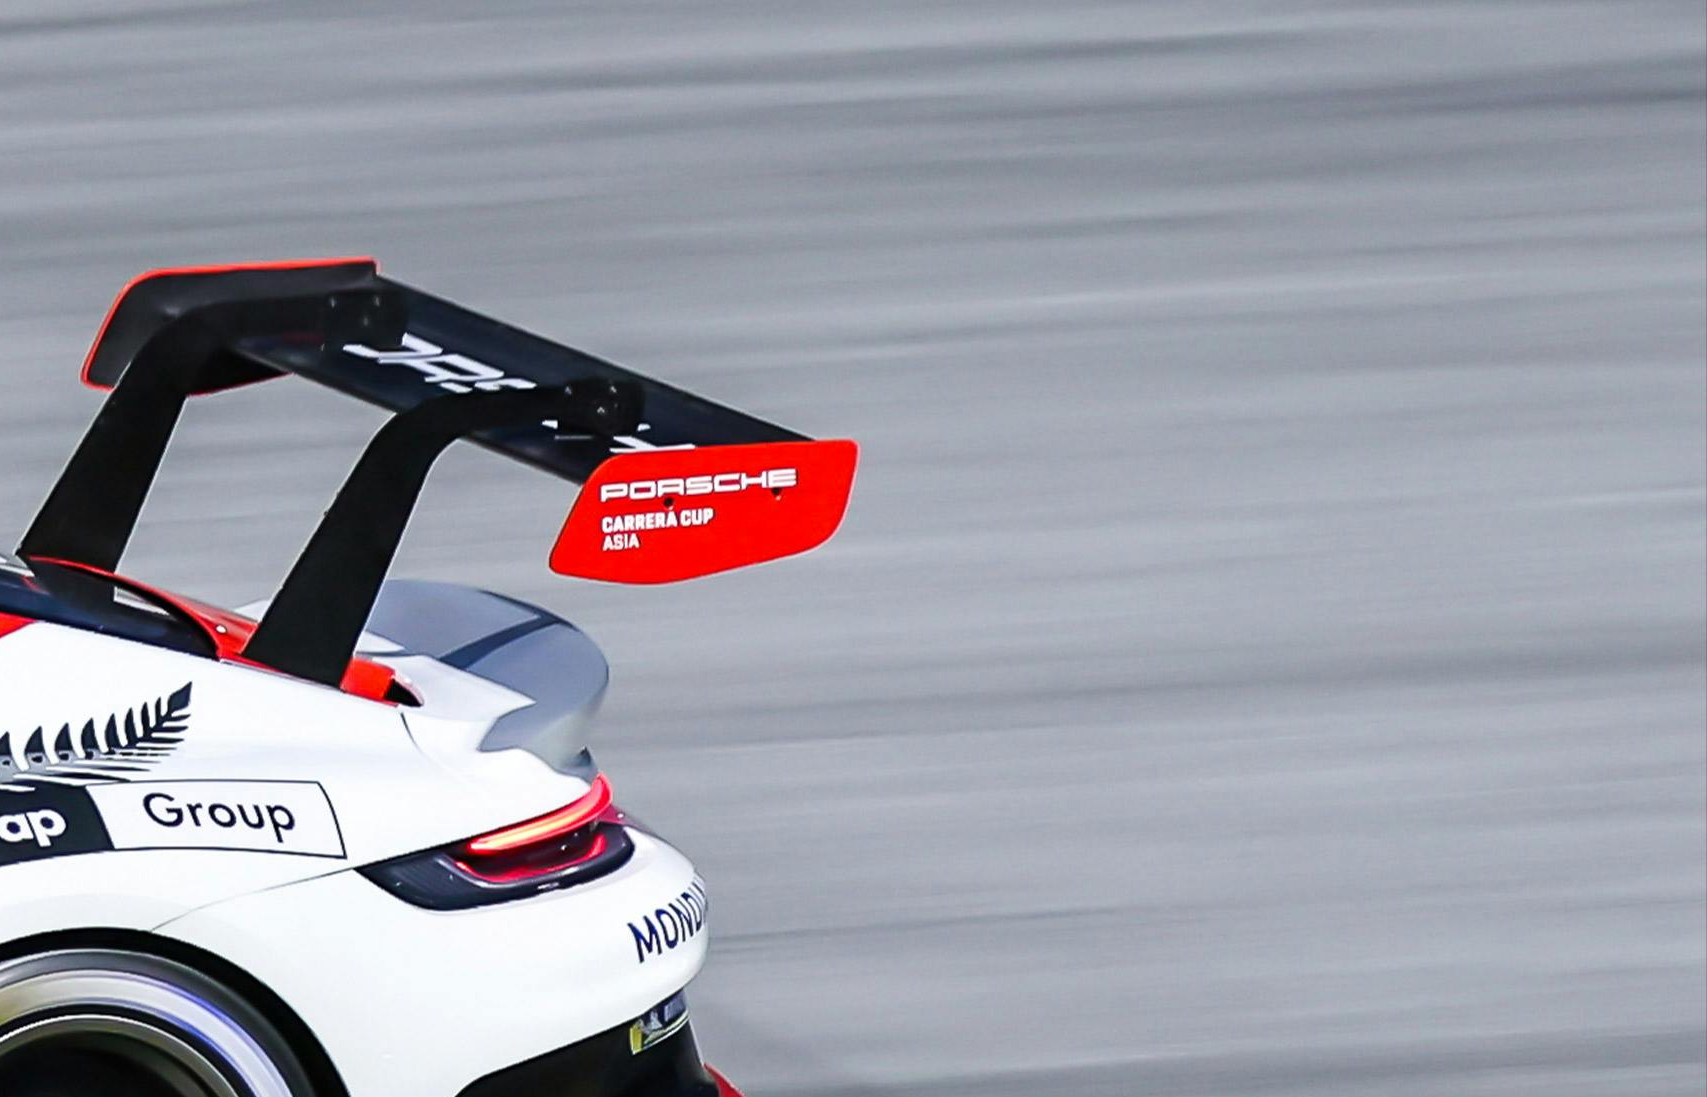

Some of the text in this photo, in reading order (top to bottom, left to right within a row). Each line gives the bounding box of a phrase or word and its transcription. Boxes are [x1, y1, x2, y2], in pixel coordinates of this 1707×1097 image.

[600, 468, 797, 503] PORSCHE
[601, 507, 715, 533] CARRERA CUP
[602, 532, 640, 551] ASIA
[143, 792, 295, 843] Group
